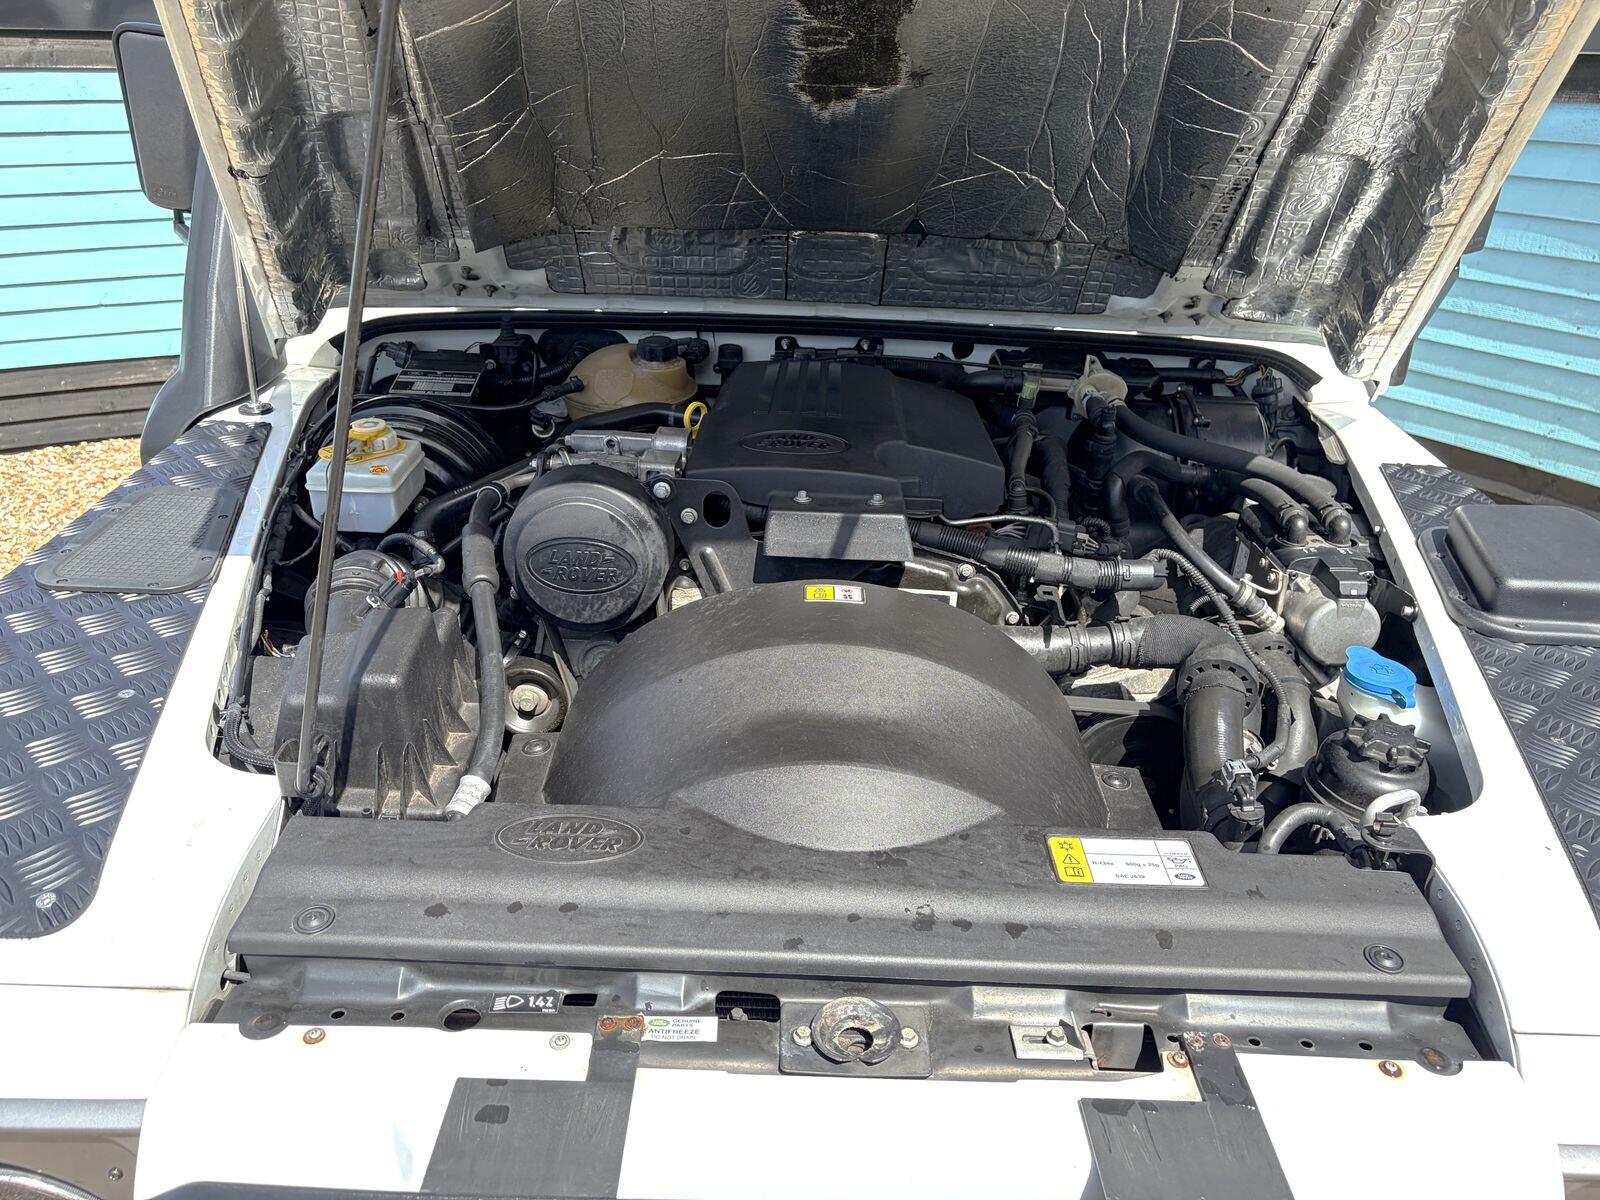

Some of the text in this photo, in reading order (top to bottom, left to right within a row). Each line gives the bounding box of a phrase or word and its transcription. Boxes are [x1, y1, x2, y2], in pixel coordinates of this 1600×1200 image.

[548, 549, 603, 566] LAND
[552, 565, 619, 583] ROVER
[525, 821, 605, 836] LAND
[524, 835, 623, 852] ROVER
